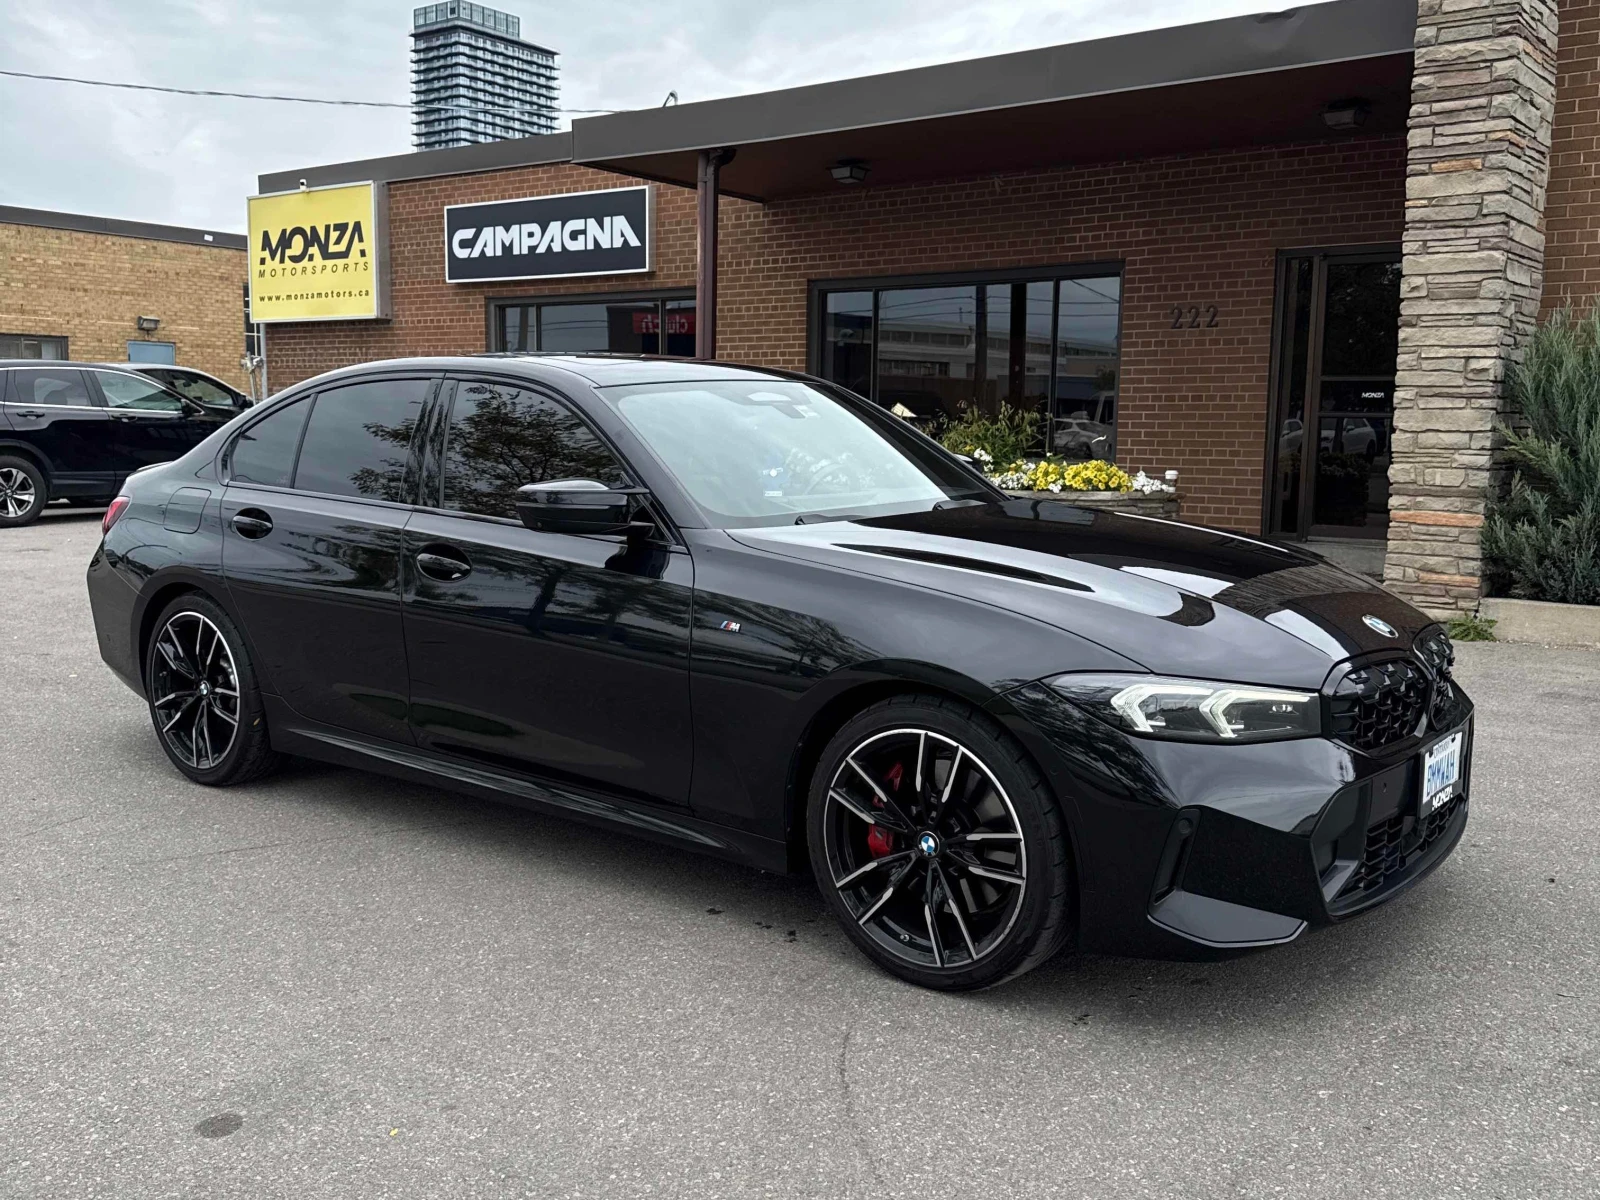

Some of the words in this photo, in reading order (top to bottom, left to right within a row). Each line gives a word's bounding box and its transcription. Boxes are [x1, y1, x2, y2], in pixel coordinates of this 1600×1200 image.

[259, 220, 367, 266] MONZA
[452, 214, 642, 259] CAMPAGNA
[258, 261, 369, 278] MOTORSPORTS
[259, 288, 370, 302] www.monzamotors.ca
[1169, 304, 1219, 330] 222
[1361, 391, 1385, 399] MONZA
[1431, 785, 1453, 811] MONZA
